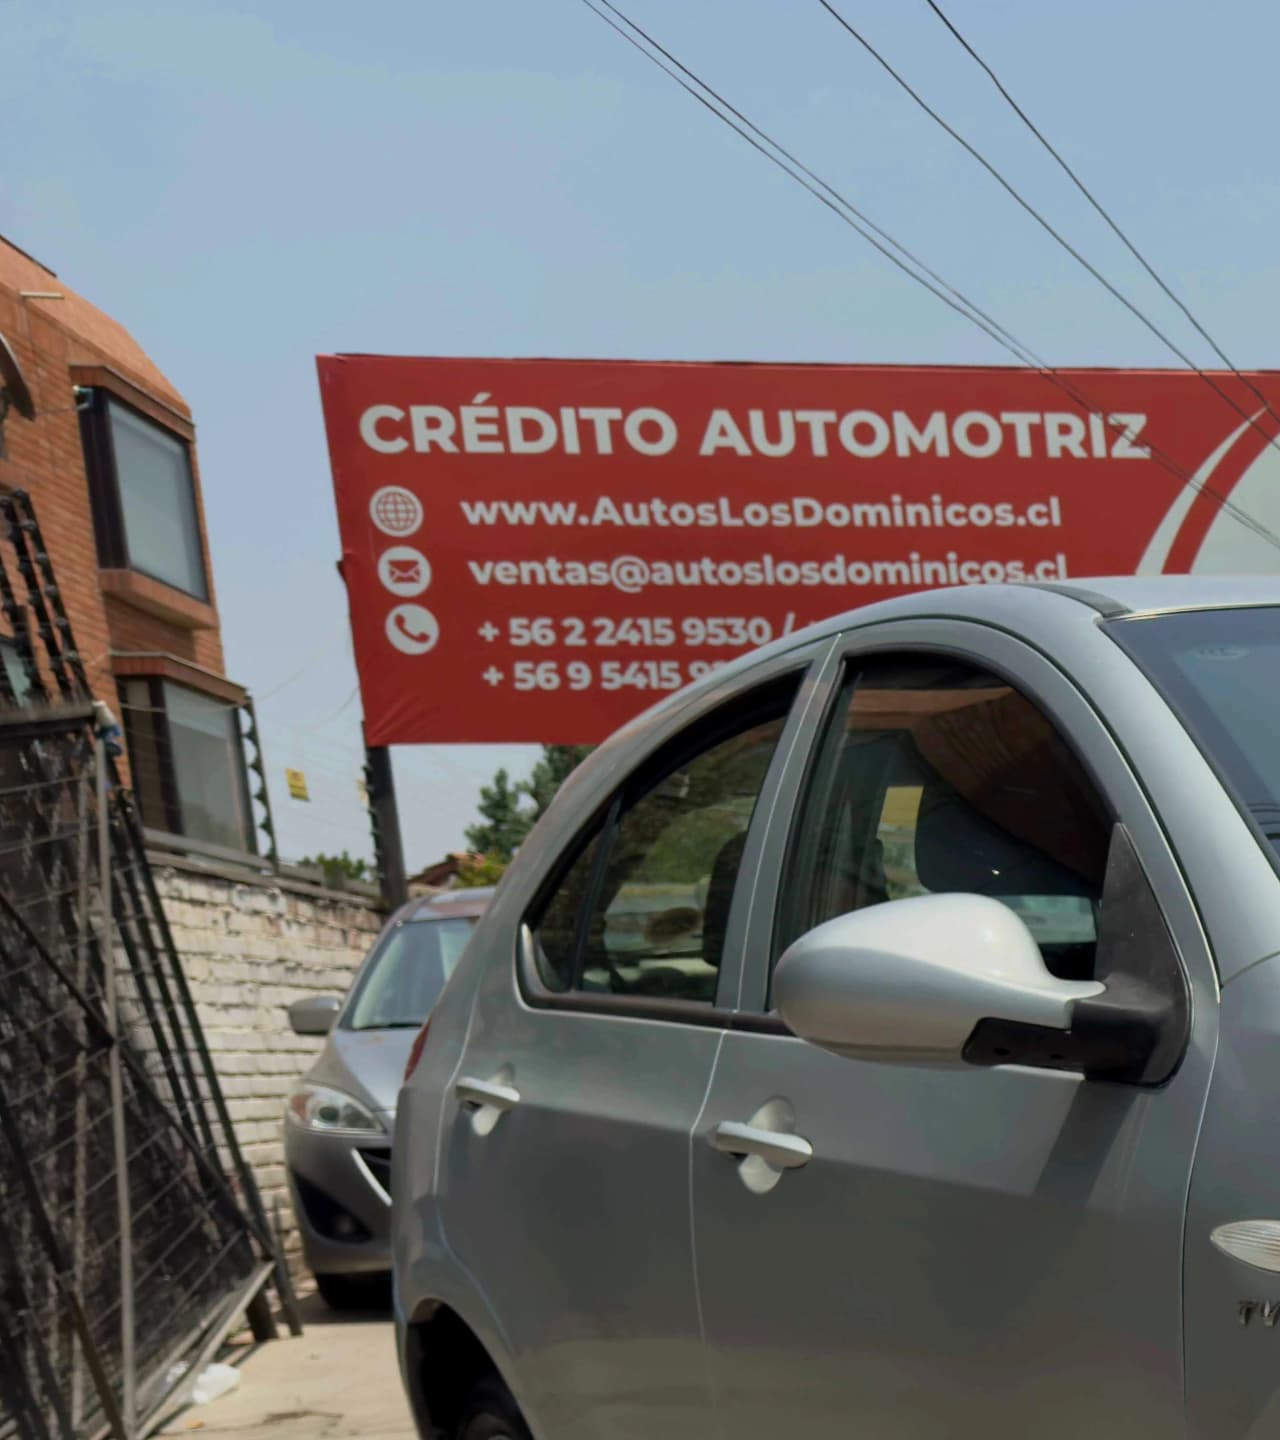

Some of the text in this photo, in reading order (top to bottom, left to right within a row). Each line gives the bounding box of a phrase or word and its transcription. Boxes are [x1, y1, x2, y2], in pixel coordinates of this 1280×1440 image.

[359, 392, 1152, 460] CRÉDITO AUTOMOTRIZ
[460, 495, 1061, 528] www.AutosLosDominicos.cl
[469, 553, 1067, 592] ventas@autoslosdominicos.cl
[508, 617, 556, 646] 56
[562, 617, 587, 646] 2
[592, 617, 676, 646] 2415
[681, 616, 773, 647] 9530
[513, 661, 561, 691] 56
[566, 661, 592, 691] 9
[601, 661, 683, 691] 5415
